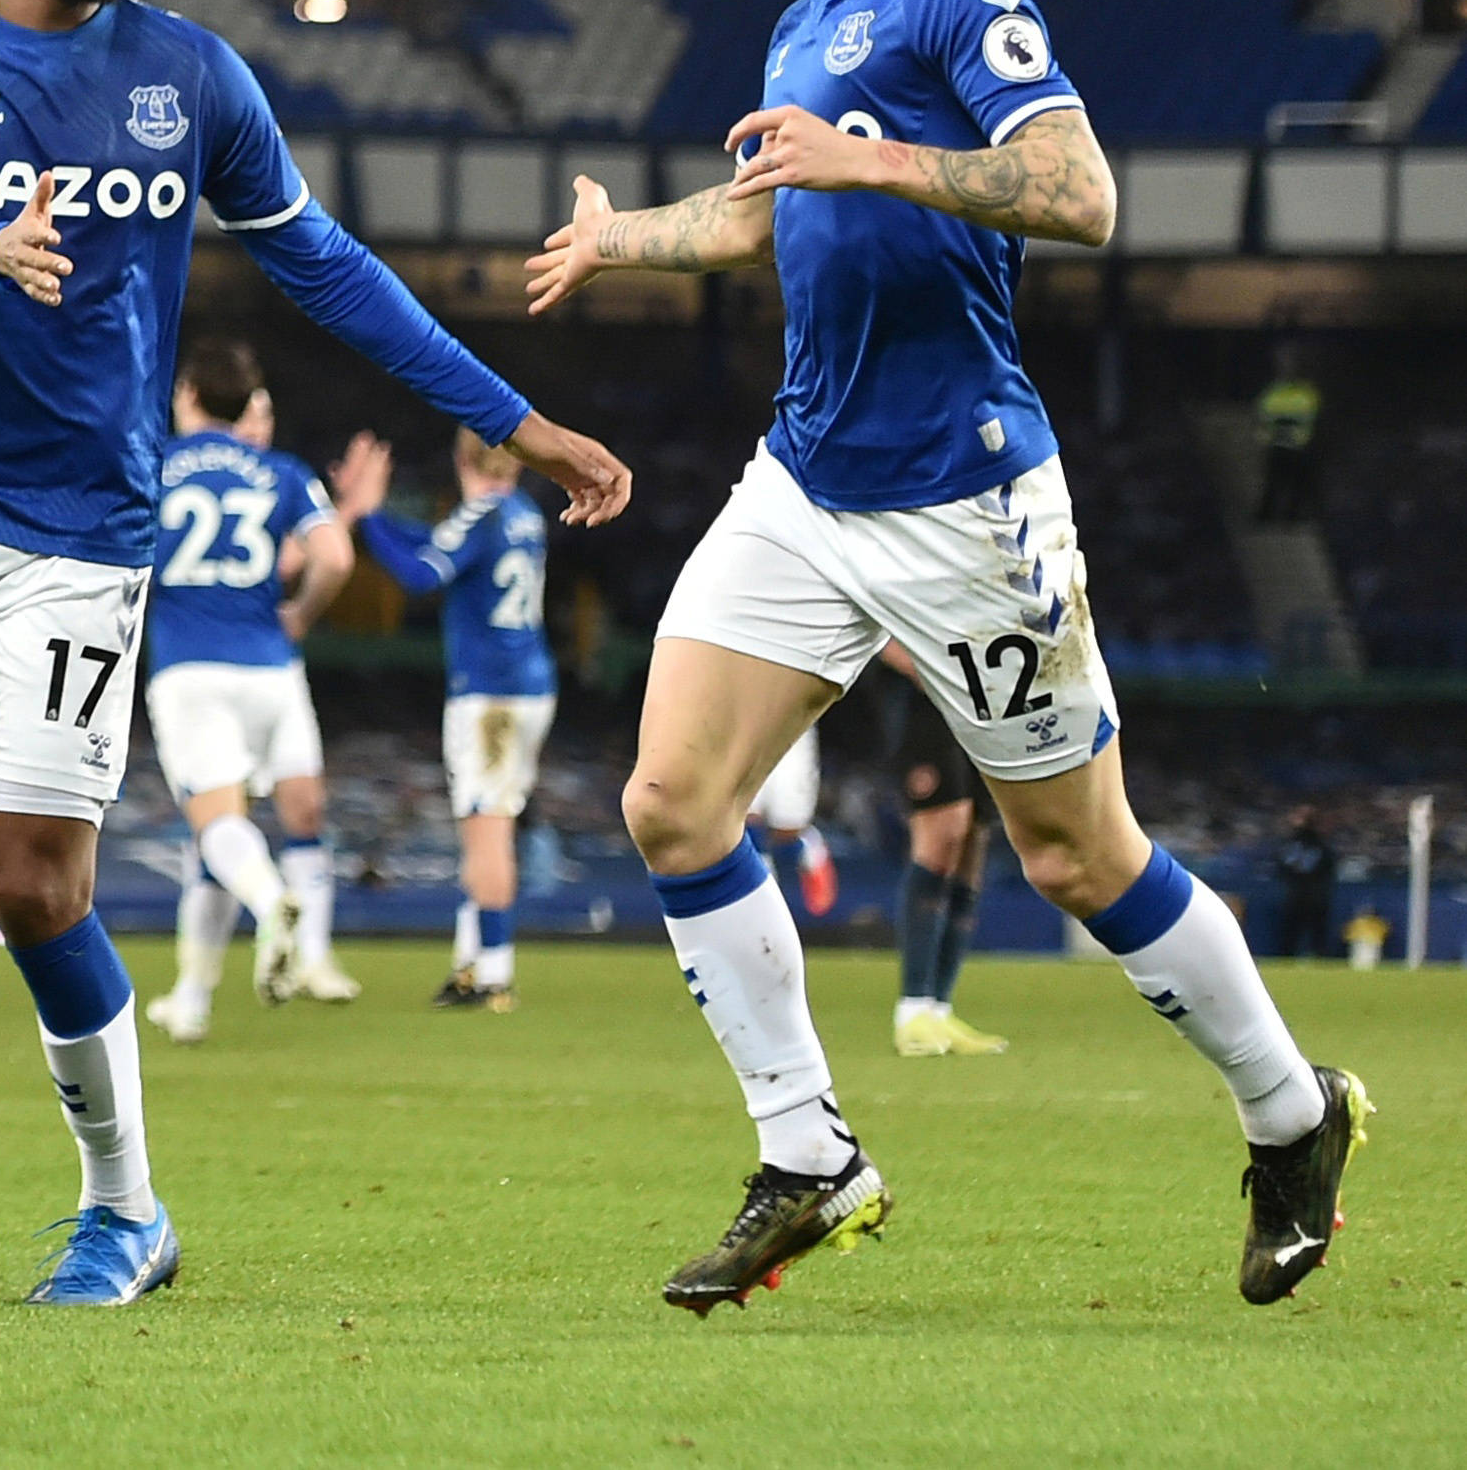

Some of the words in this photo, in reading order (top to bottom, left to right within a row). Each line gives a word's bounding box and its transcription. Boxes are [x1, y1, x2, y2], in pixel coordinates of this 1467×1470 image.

[160, 483, 278, 588] 23
[44, 637, 122, 729] 17
[948, 634, 1053, 721] 12
[1026, 733, 1069, 755] hummel
